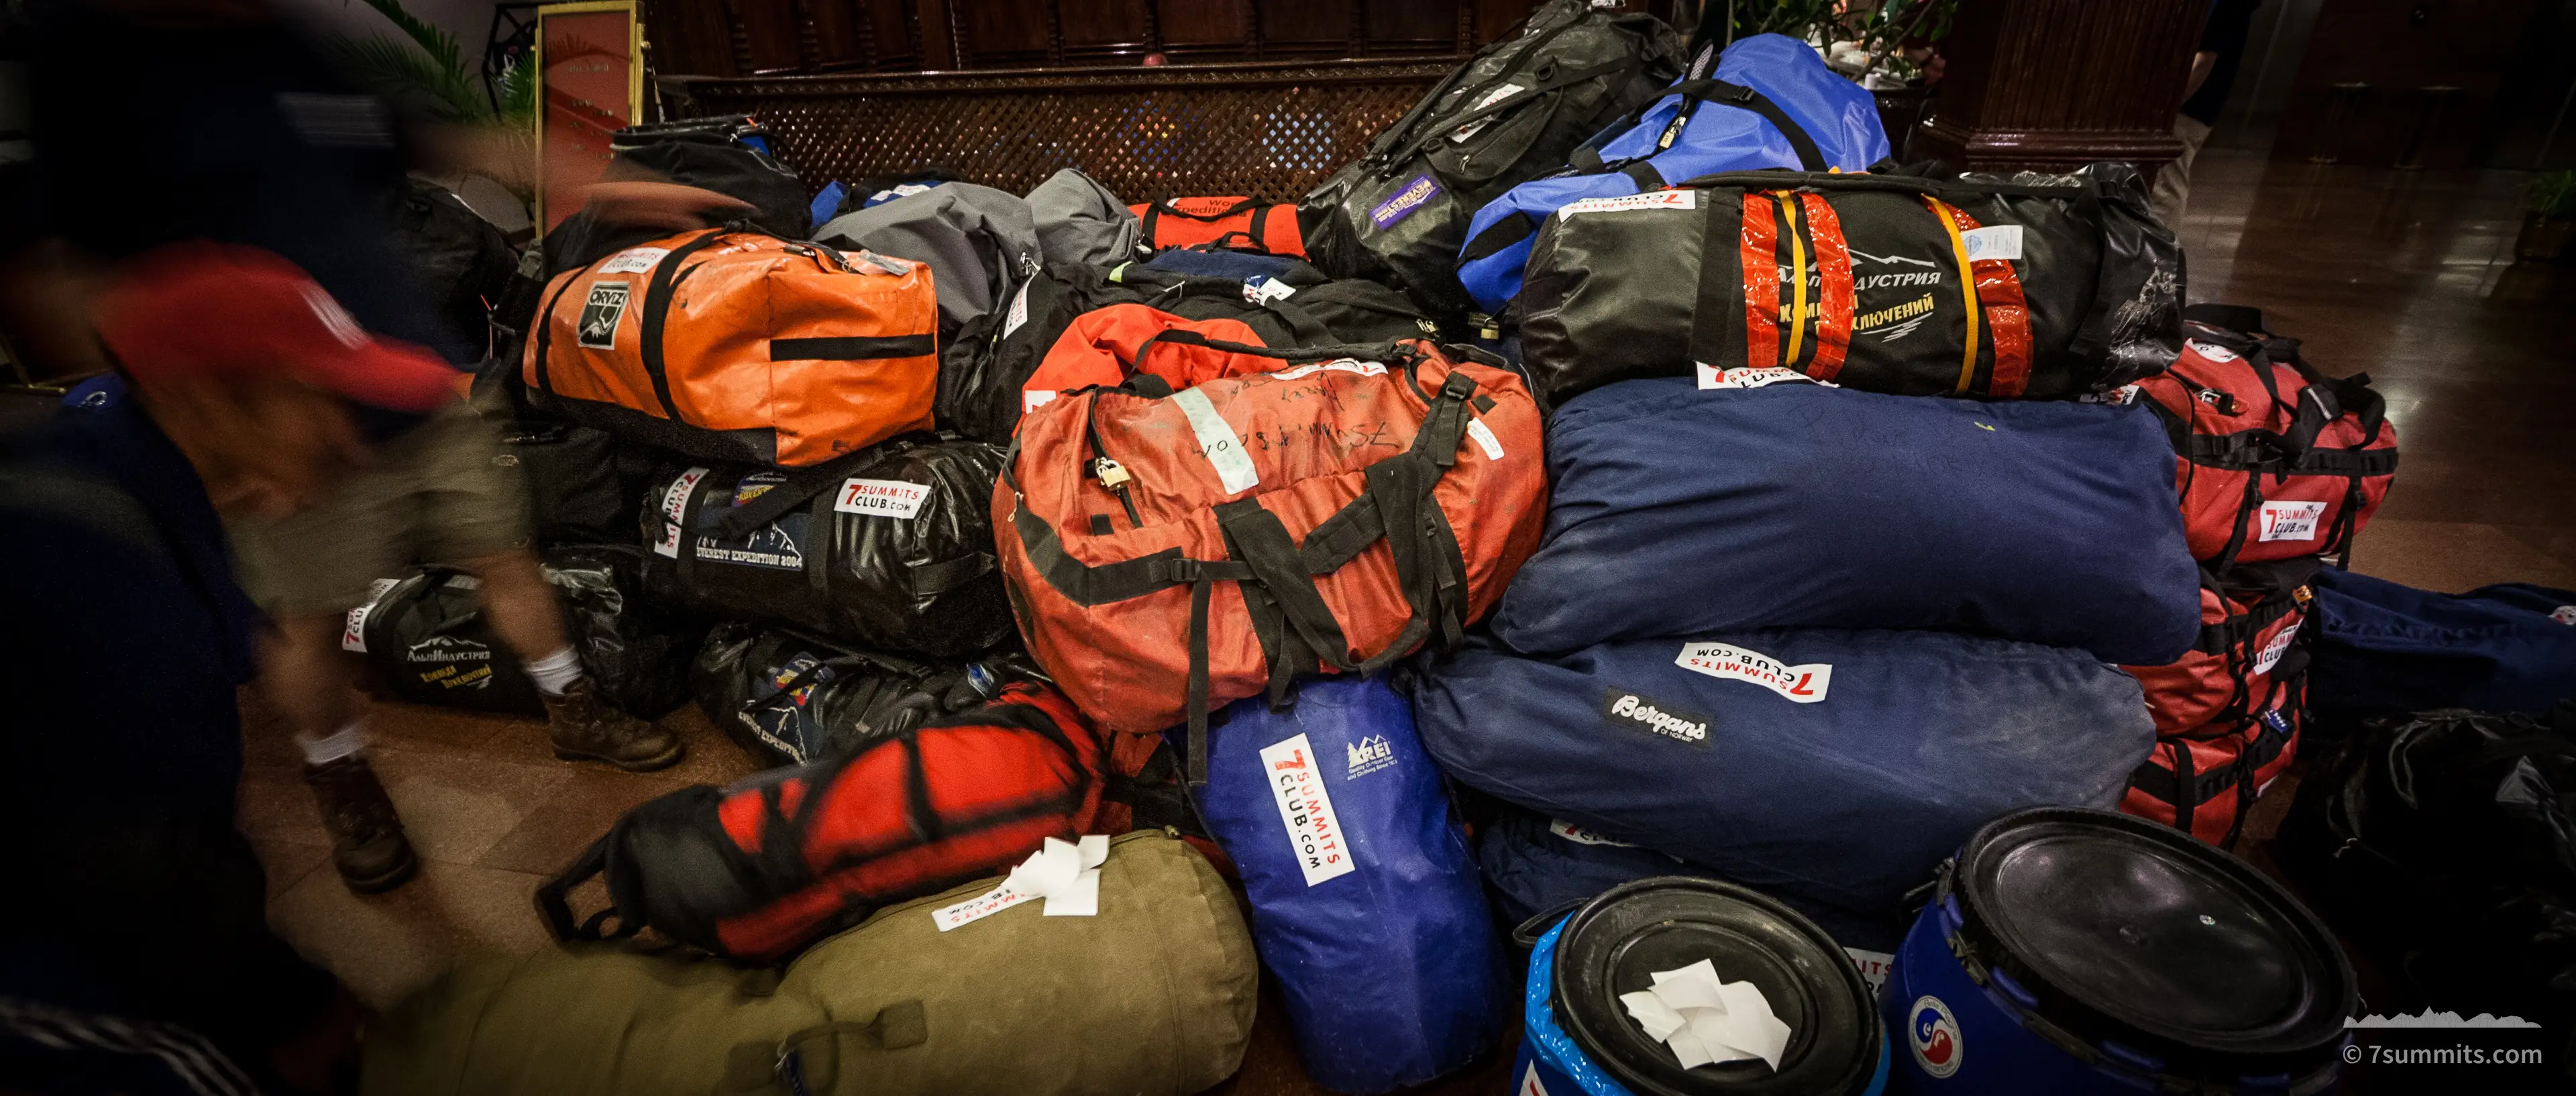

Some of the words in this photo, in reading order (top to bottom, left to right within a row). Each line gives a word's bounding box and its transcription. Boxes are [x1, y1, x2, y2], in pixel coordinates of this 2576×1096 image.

[589, 290, 625, 305] ORVIZ
[846, 484, 863, 505] 7
[861, 486, 918, 500] SUMMITS
[855, 496, 912, 511] CLUB.COM
[2265, 509, 2277, 533] 7
[2279, 510, 2318, 519] SUMMITS
[732, 550, 780, 565] EXPEDITION
[781, 555, 802, 567] 2004
[1690, 658, 1787, 690] SUMMITS
[1697, 649, 1795, 682] CLUB.COM
[1789, 673, 1814, 695] 7
[1611, 695, 1707, 740] Bergans
[1275, 749, 1307, 771] 7
[1297, 771, 1340, 865] SUMMITS
[1280, 773, 1321, 869] CLUB.COM
